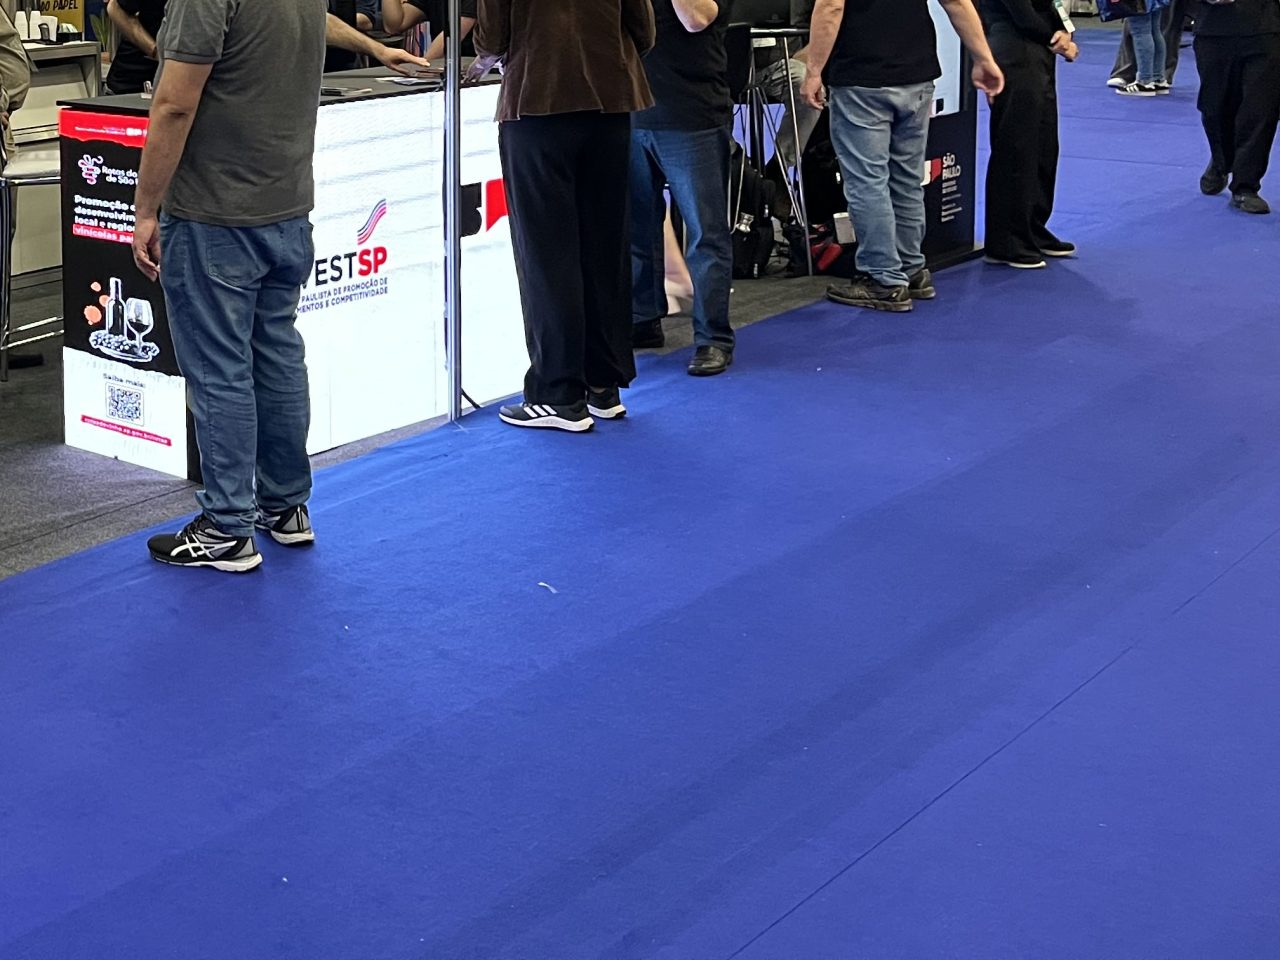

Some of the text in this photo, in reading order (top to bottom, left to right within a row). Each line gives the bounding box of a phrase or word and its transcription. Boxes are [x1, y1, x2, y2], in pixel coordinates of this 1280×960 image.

[53, 0, 78, 11] PAPEL
[942, 152, 956, 167] SÃO
[74, 194, 129, 211] Promoção
[74, 216, 98, 226] local
[301, 277, 388, 303] PAULISTA DE PROMOÇÃO DE
[330, 286, 388, 306] COMPETITIVIDADE
